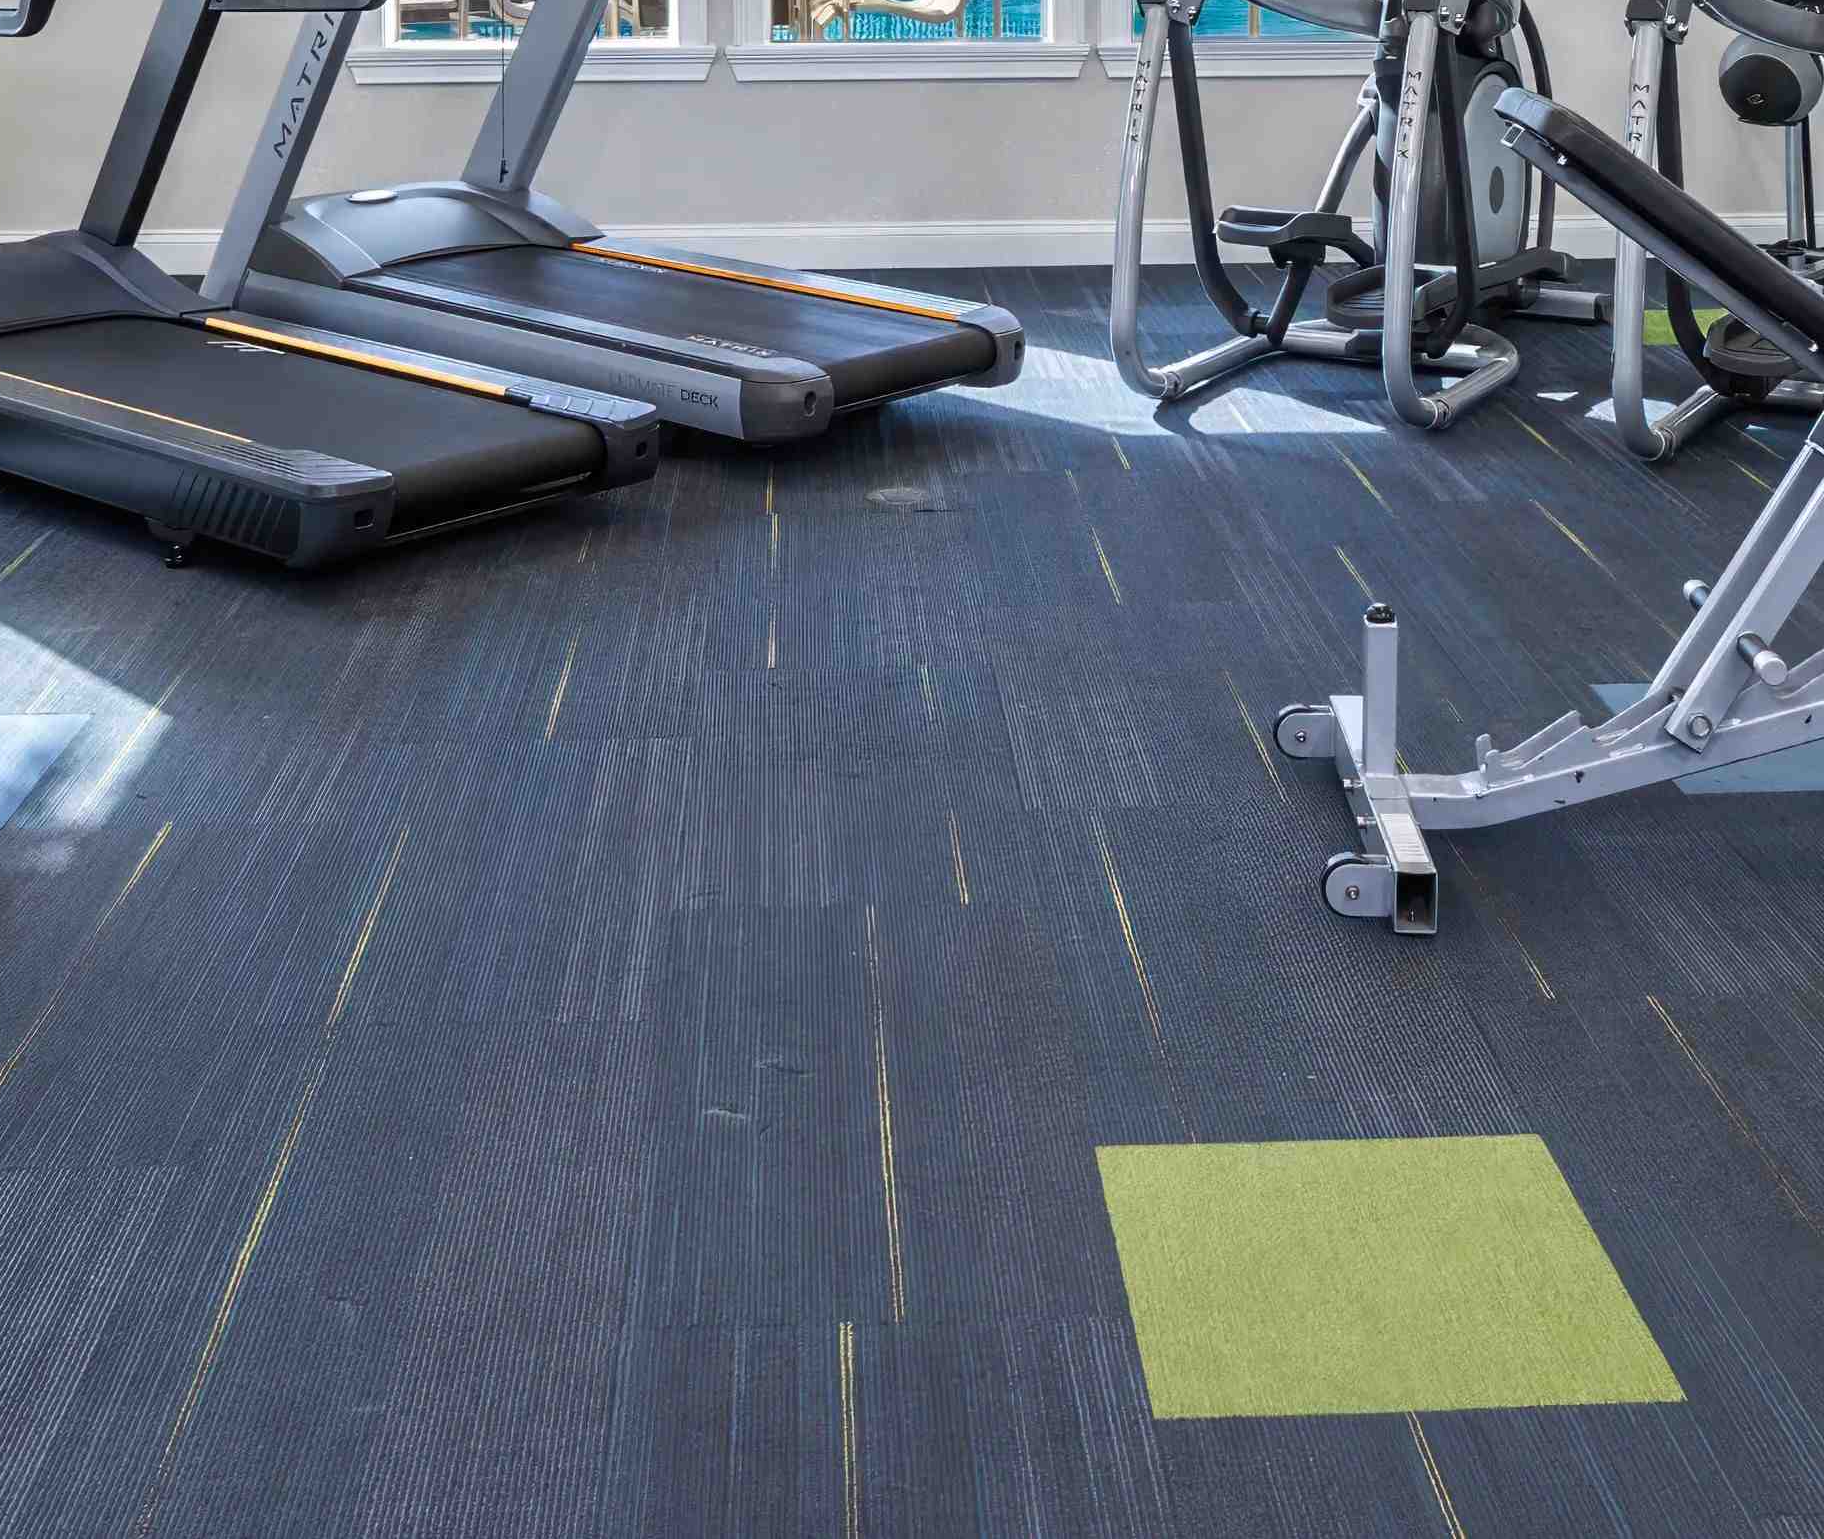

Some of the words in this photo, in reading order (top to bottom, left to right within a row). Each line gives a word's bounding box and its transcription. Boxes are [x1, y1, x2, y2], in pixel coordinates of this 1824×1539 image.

[1397, 70, 1422, 158] MATRIX
[1628, 84, 1650, 157] MATRI
[680, 388, 719, 408] DECK
